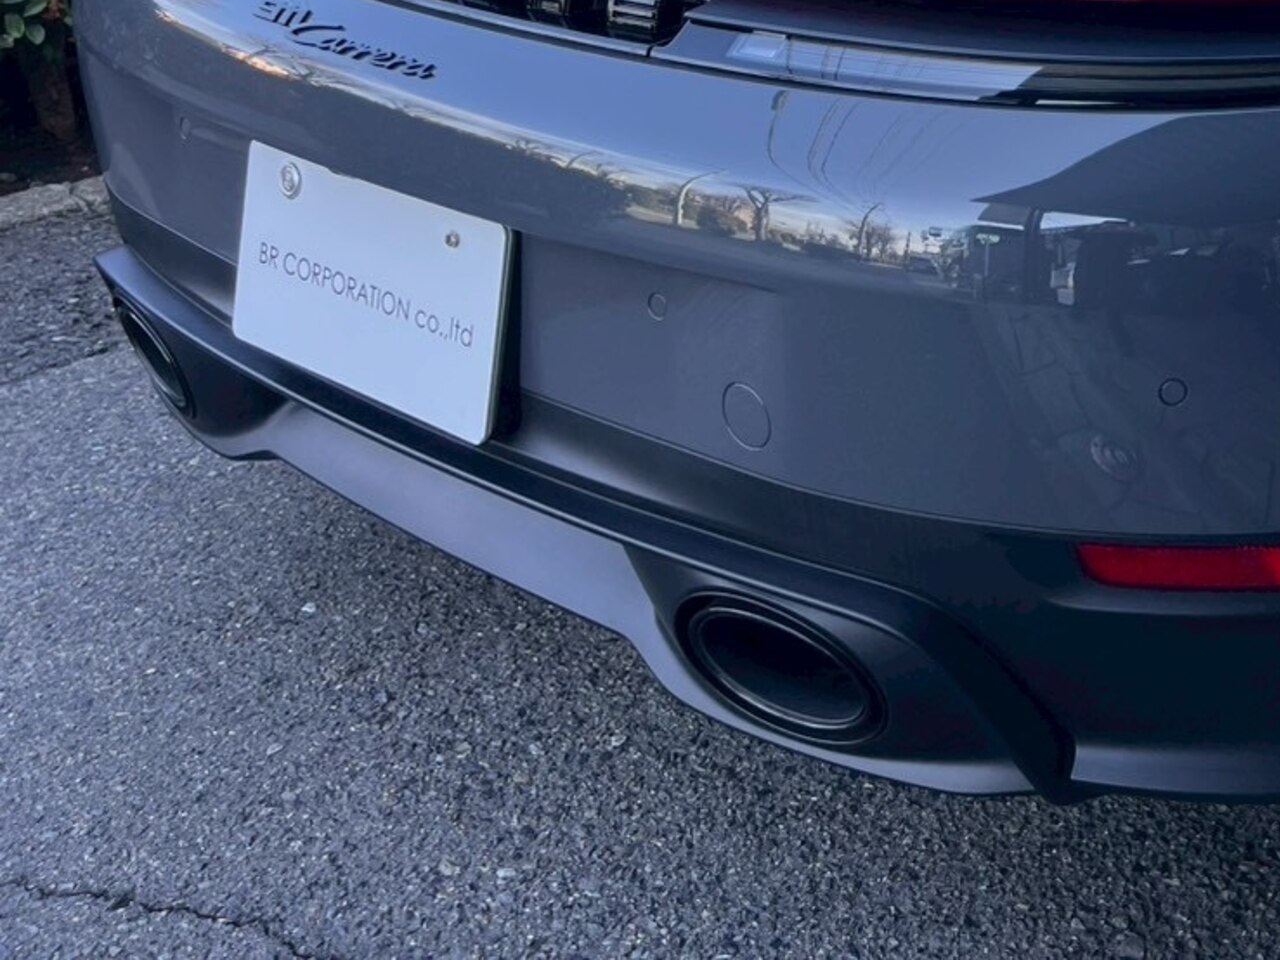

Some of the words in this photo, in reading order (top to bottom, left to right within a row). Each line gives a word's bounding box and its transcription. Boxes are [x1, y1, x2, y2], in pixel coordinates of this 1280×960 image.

[285, 25, 438, 80] Carrera
[259, 242, 280, 268] BR
[283, 252, 411, 321] CORPORATION
